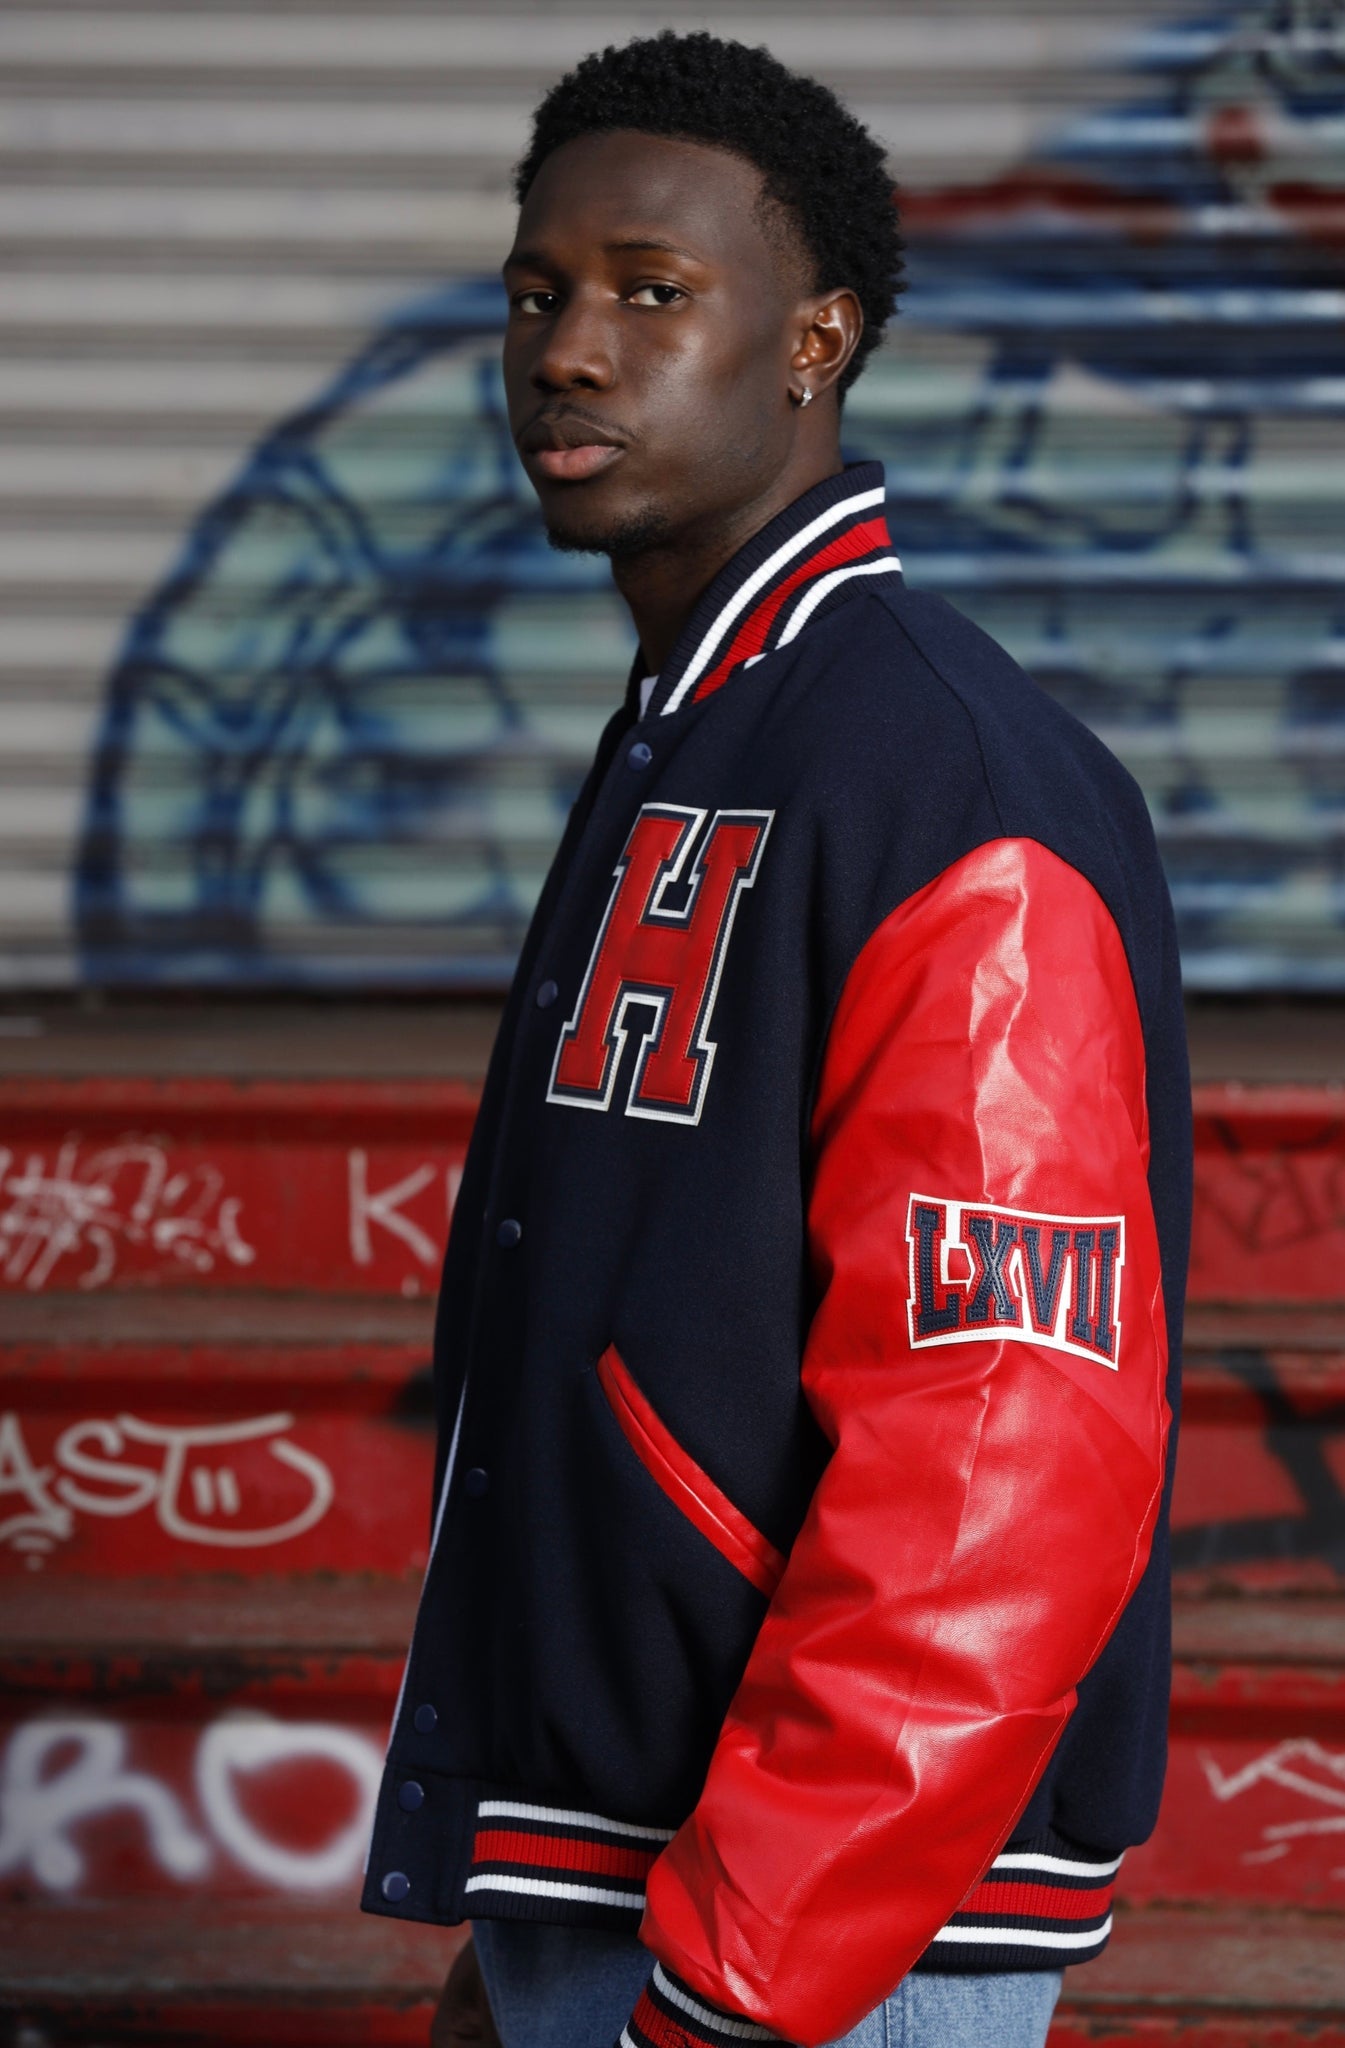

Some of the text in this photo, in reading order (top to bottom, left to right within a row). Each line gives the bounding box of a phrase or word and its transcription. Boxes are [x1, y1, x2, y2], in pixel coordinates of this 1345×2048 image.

[546, 802, 776, 1126] H
[347, 1148, 464, 1266] K
[906, 1193, 1125, 1371] LXVII
